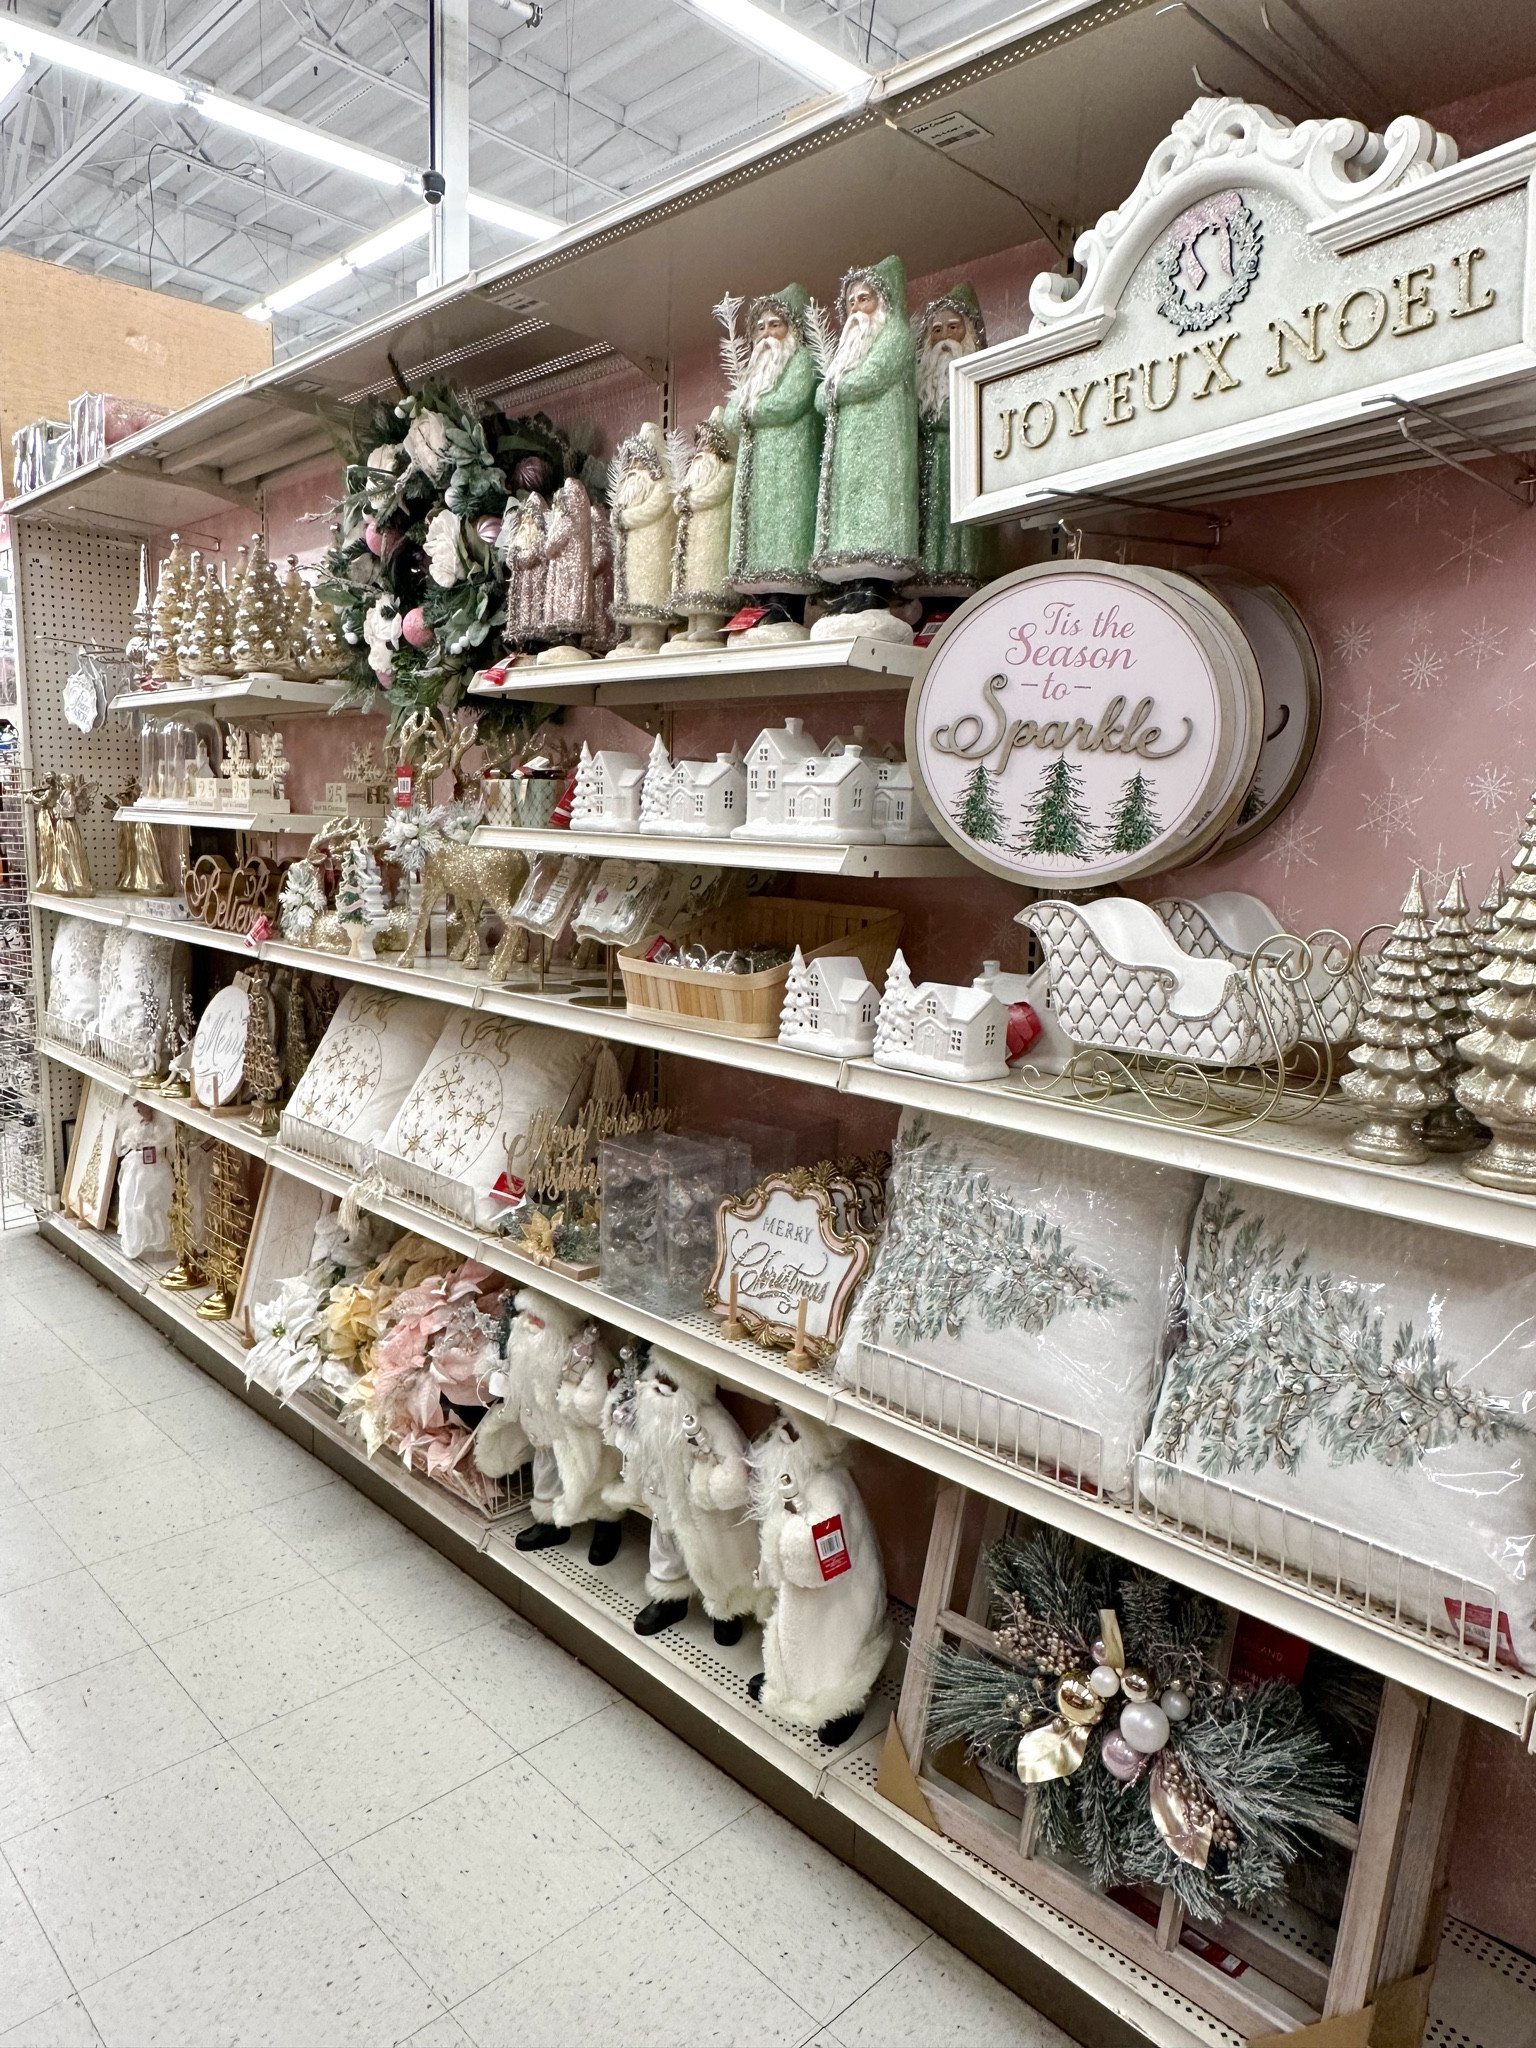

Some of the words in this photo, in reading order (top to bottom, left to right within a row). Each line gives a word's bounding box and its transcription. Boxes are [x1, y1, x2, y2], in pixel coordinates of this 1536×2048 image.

[993, 332, 1242, 460] JOYEUX
[1265, 246, 1496, 378] NOEL
[1004, 622, 1138, 670] Season
[1043, 601, 1084, 636] Tis
[1092, 604, 1136, 639] the
[930, 672, 1194, 776] Sparkle
[762, 1216, 815, 1245] MERRY
[730, 1228, 830, 1314] Christmas
